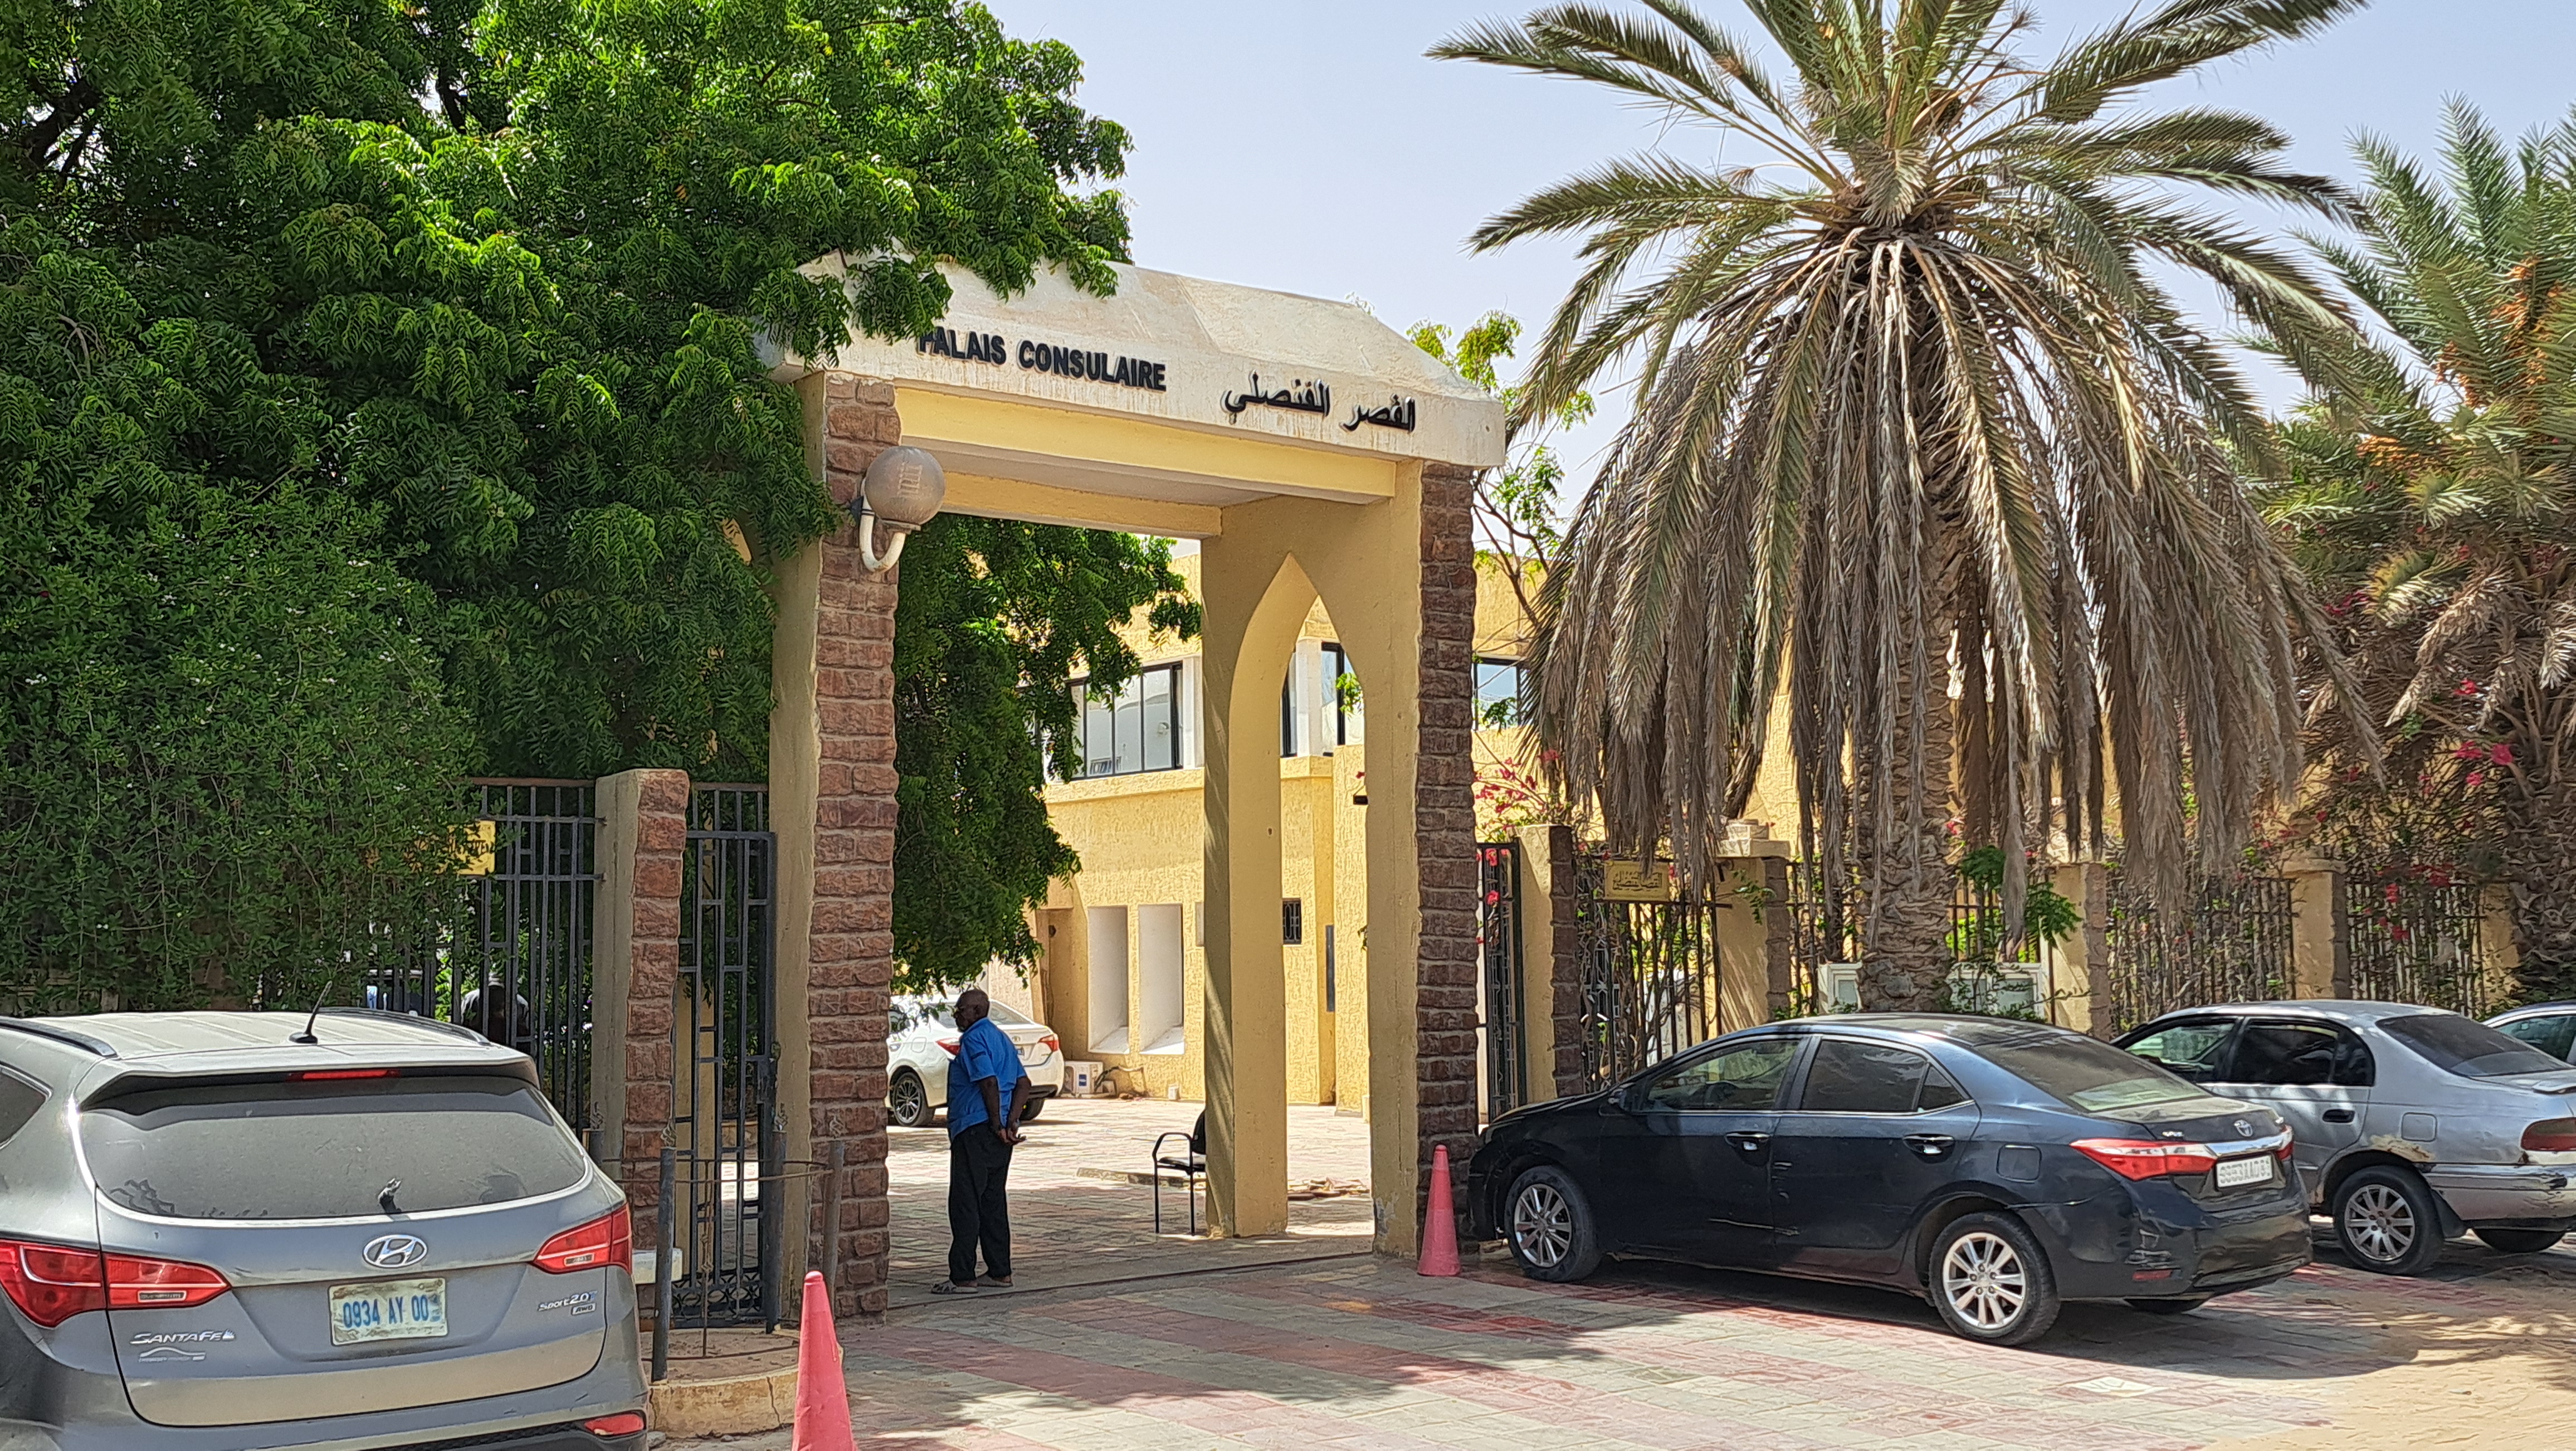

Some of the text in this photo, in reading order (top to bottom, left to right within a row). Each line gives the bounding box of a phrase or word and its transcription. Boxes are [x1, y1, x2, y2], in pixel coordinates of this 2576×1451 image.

[919, 325, 1167, 392] PALAIS CONSULAIRE
[343, 1294, 429, 1328] 0934 AY 00
